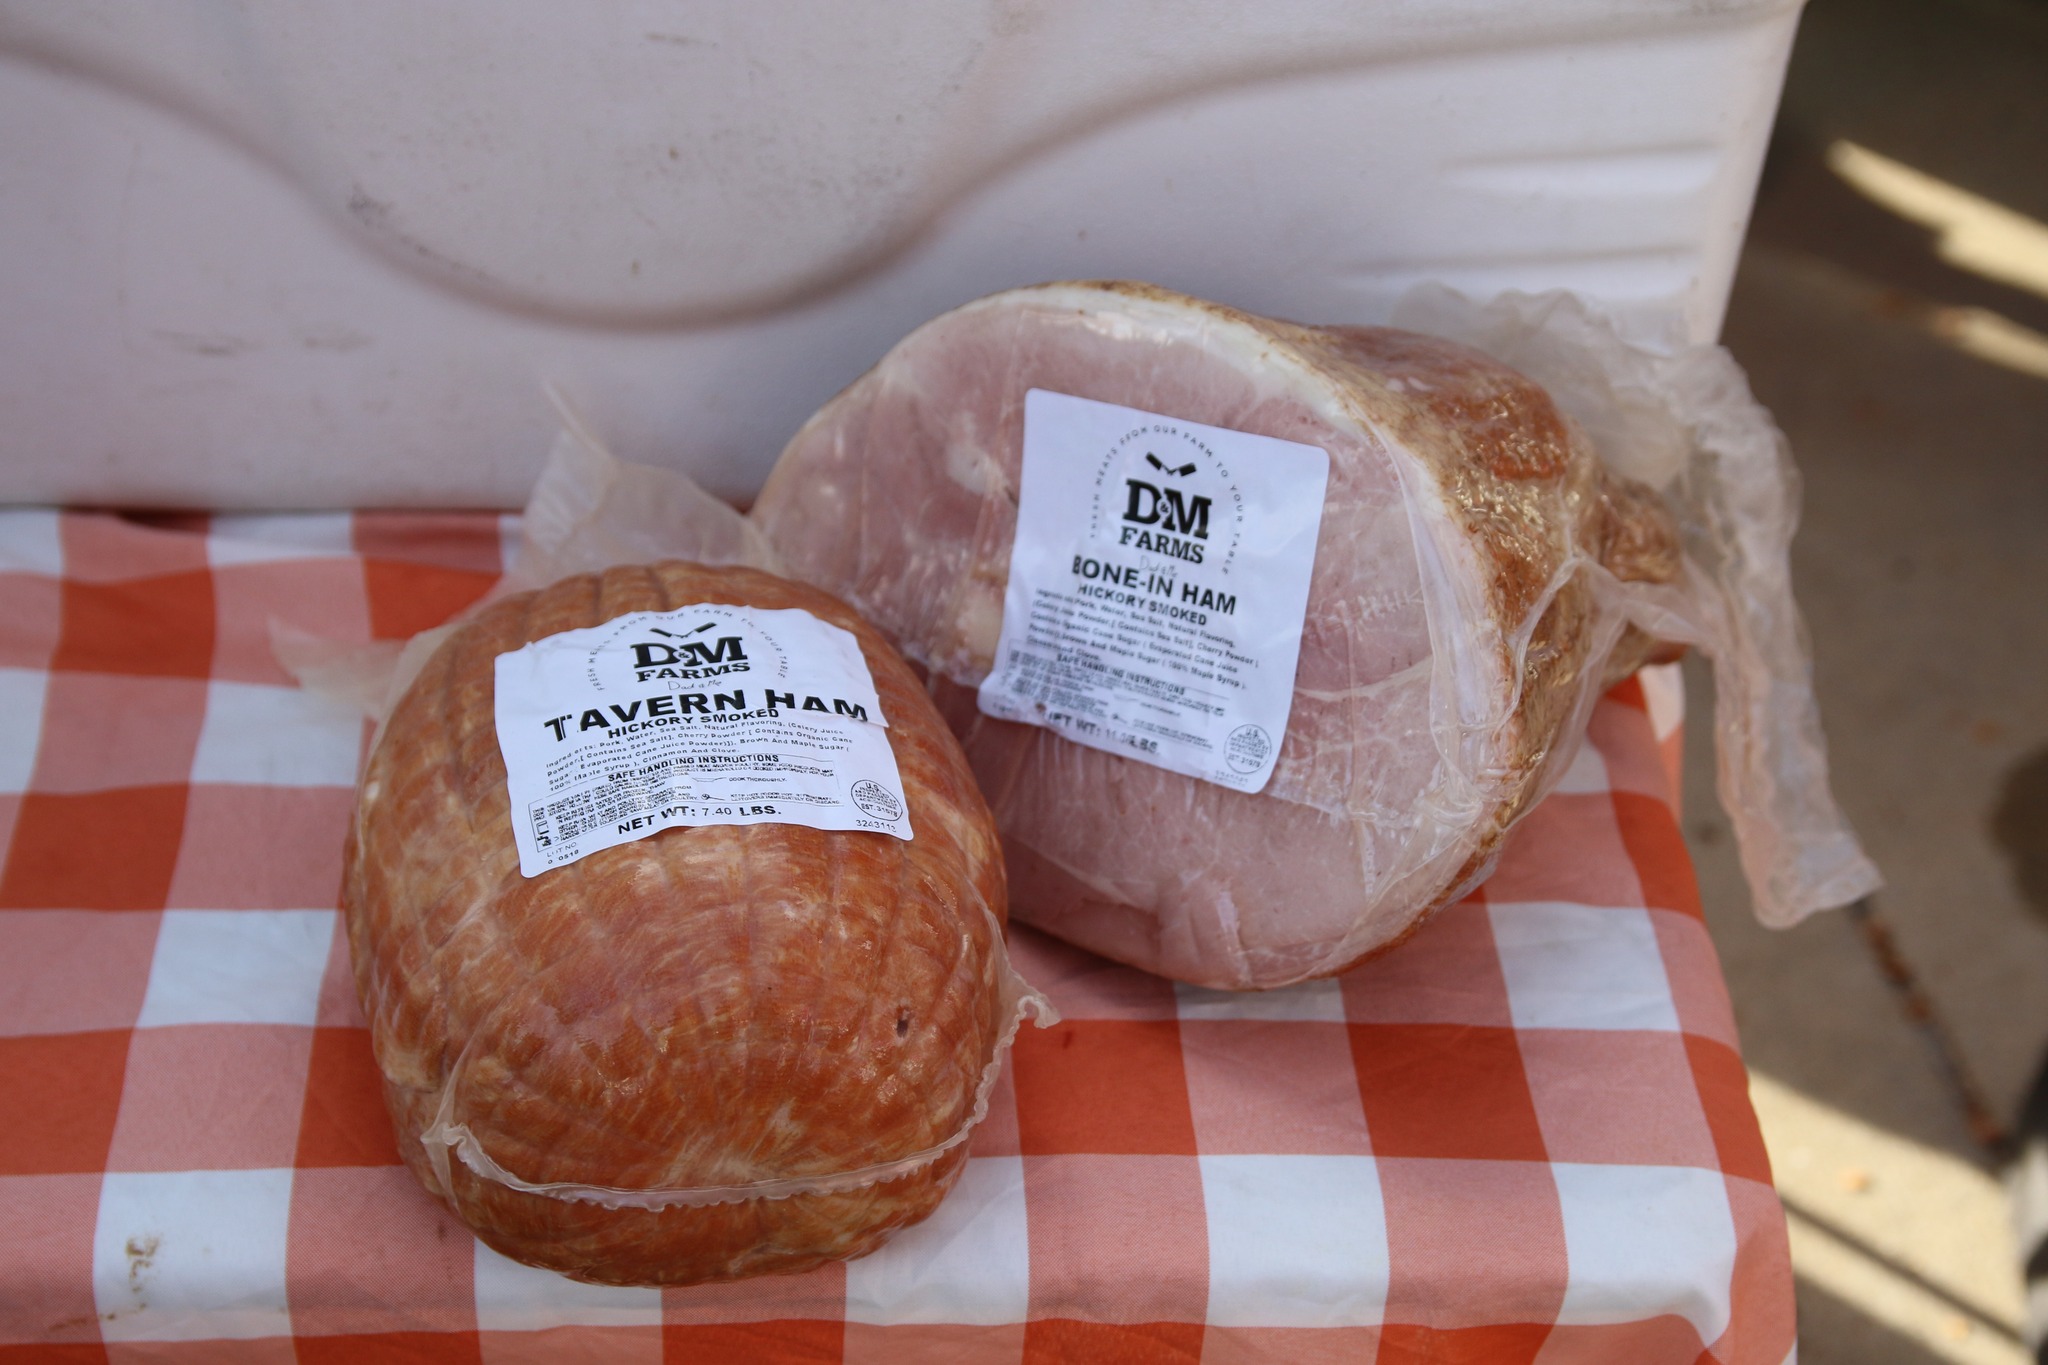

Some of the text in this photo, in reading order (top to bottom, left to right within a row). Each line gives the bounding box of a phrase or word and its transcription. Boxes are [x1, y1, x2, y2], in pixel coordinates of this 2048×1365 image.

[1153, 425, 1177, 435] OUR
[1122, 478, 1212, 540] D&M
[1118, 525, 1205, 564] FARMS
[1072, 554, 1237, 616] BONE-IN HAM
[1077, 584, 1148, 609] HICKORY
[1148, 600, 1207, 626] SMOKED
[630, 636, 749, 669] D&M
[635, 662, 750, 682] FARMS
[544, 688, 868, 742] TAVERN HAM
[607, 708, 779, 739] HICKORY SMOKED
[704, 723, 738, 731] Natural
[580, 754, 632, 770] Evaporated
[635, 747, 657, 757] Cane
[660, 741, 686, 749] Juice
[791, 739, 816, 748] Maple
[586, 747, 627, 759] Contains
[630, 741, 647, 750] Sea
[796, 731, 829, 742] Organic
[604, 763, 630, 773] Syrup
[642, 749, 687, 763] Cinnamon
[608, 770, 636, 782] SAFE
[639, 757, 695, 776] HANDLING
[698, 754, 779, 764] INSTRUCTIONS
[617, 805, 782, 835] NET WT: 7.40 LBS.
